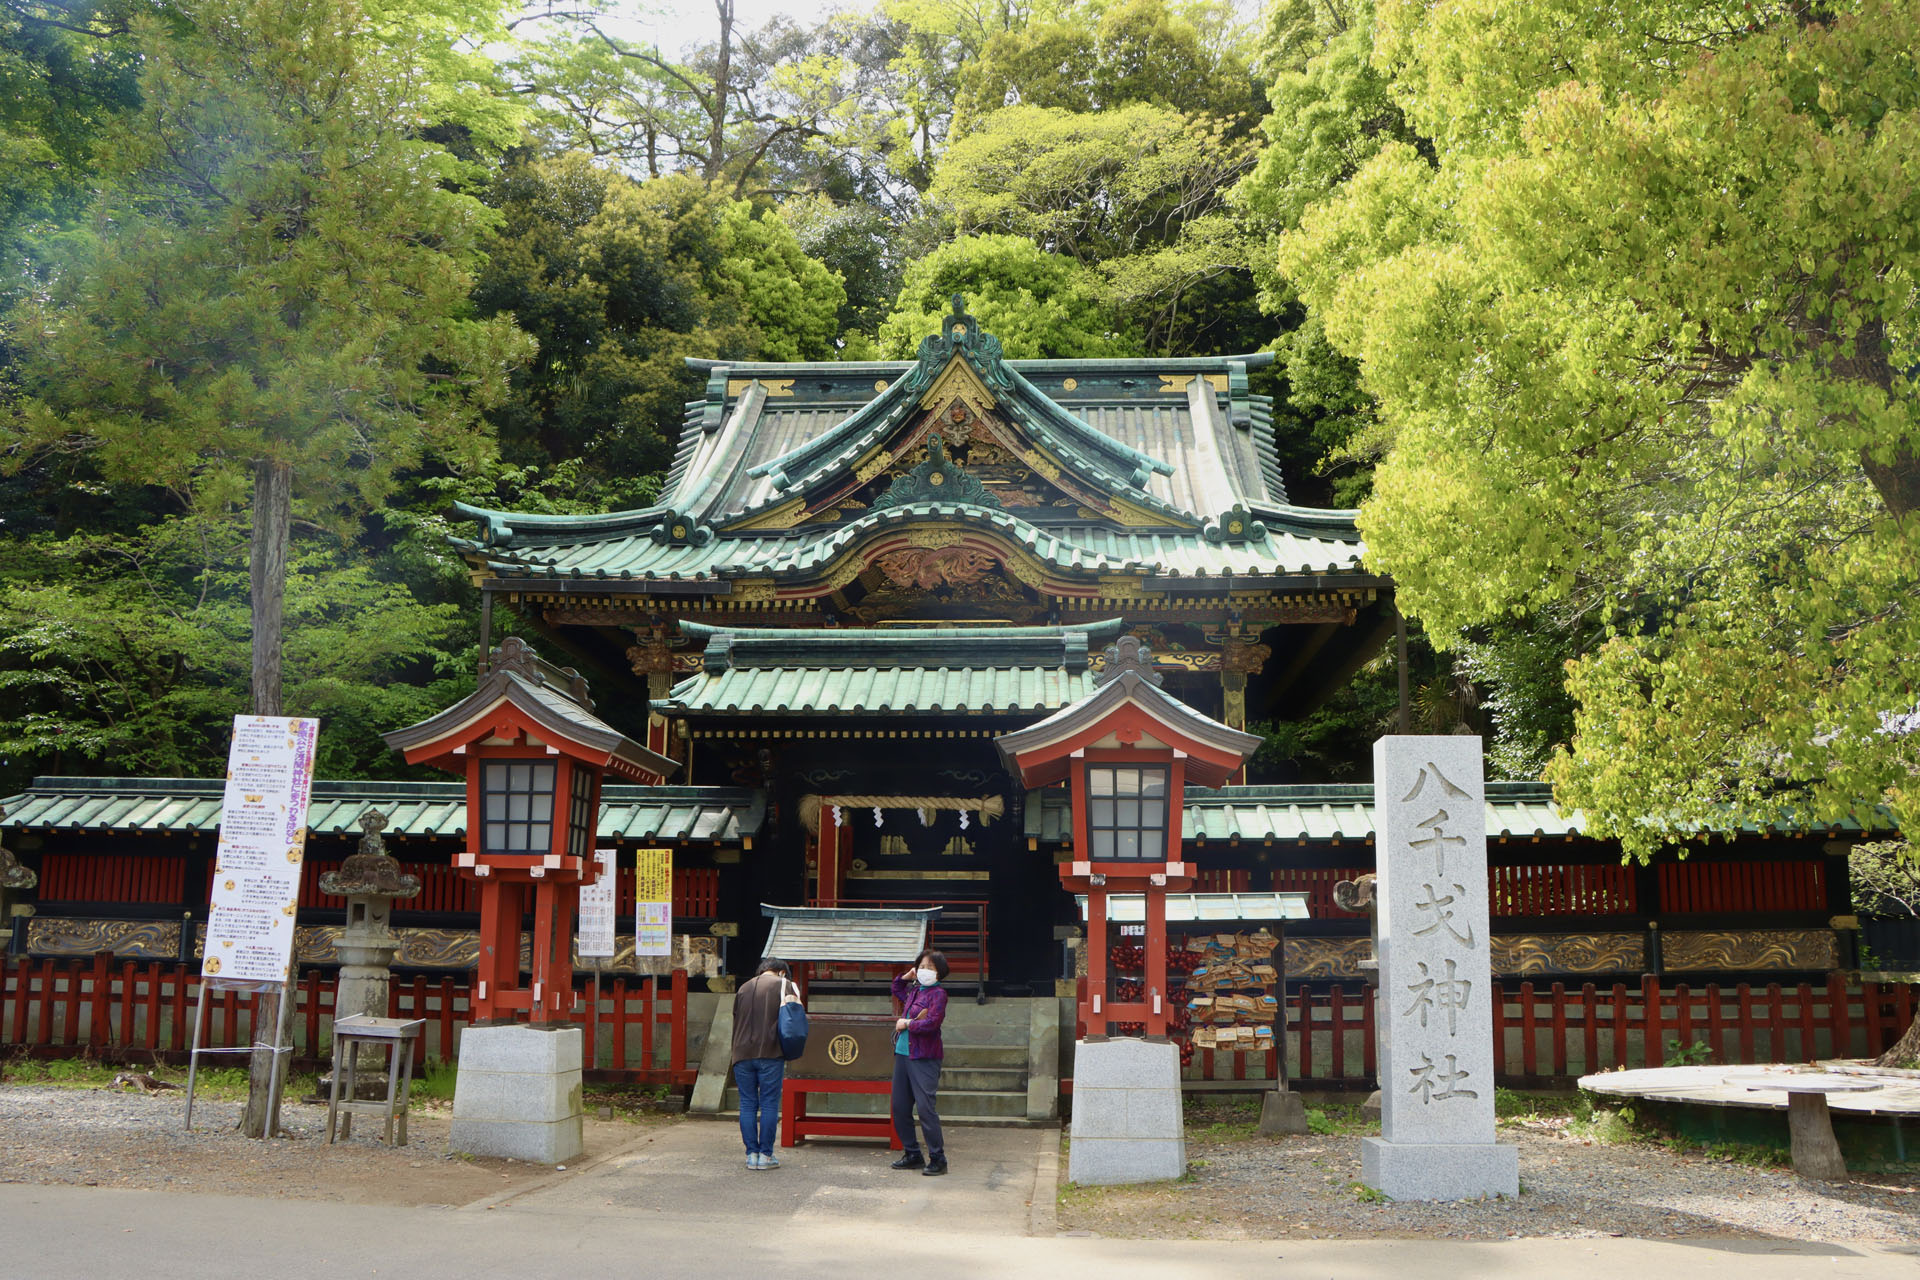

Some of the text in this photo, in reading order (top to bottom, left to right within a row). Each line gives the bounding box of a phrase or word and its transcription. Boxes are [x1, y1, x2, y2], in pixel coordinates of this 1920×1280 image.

[1401, 762, 1478, 1105] 八千戈神社
